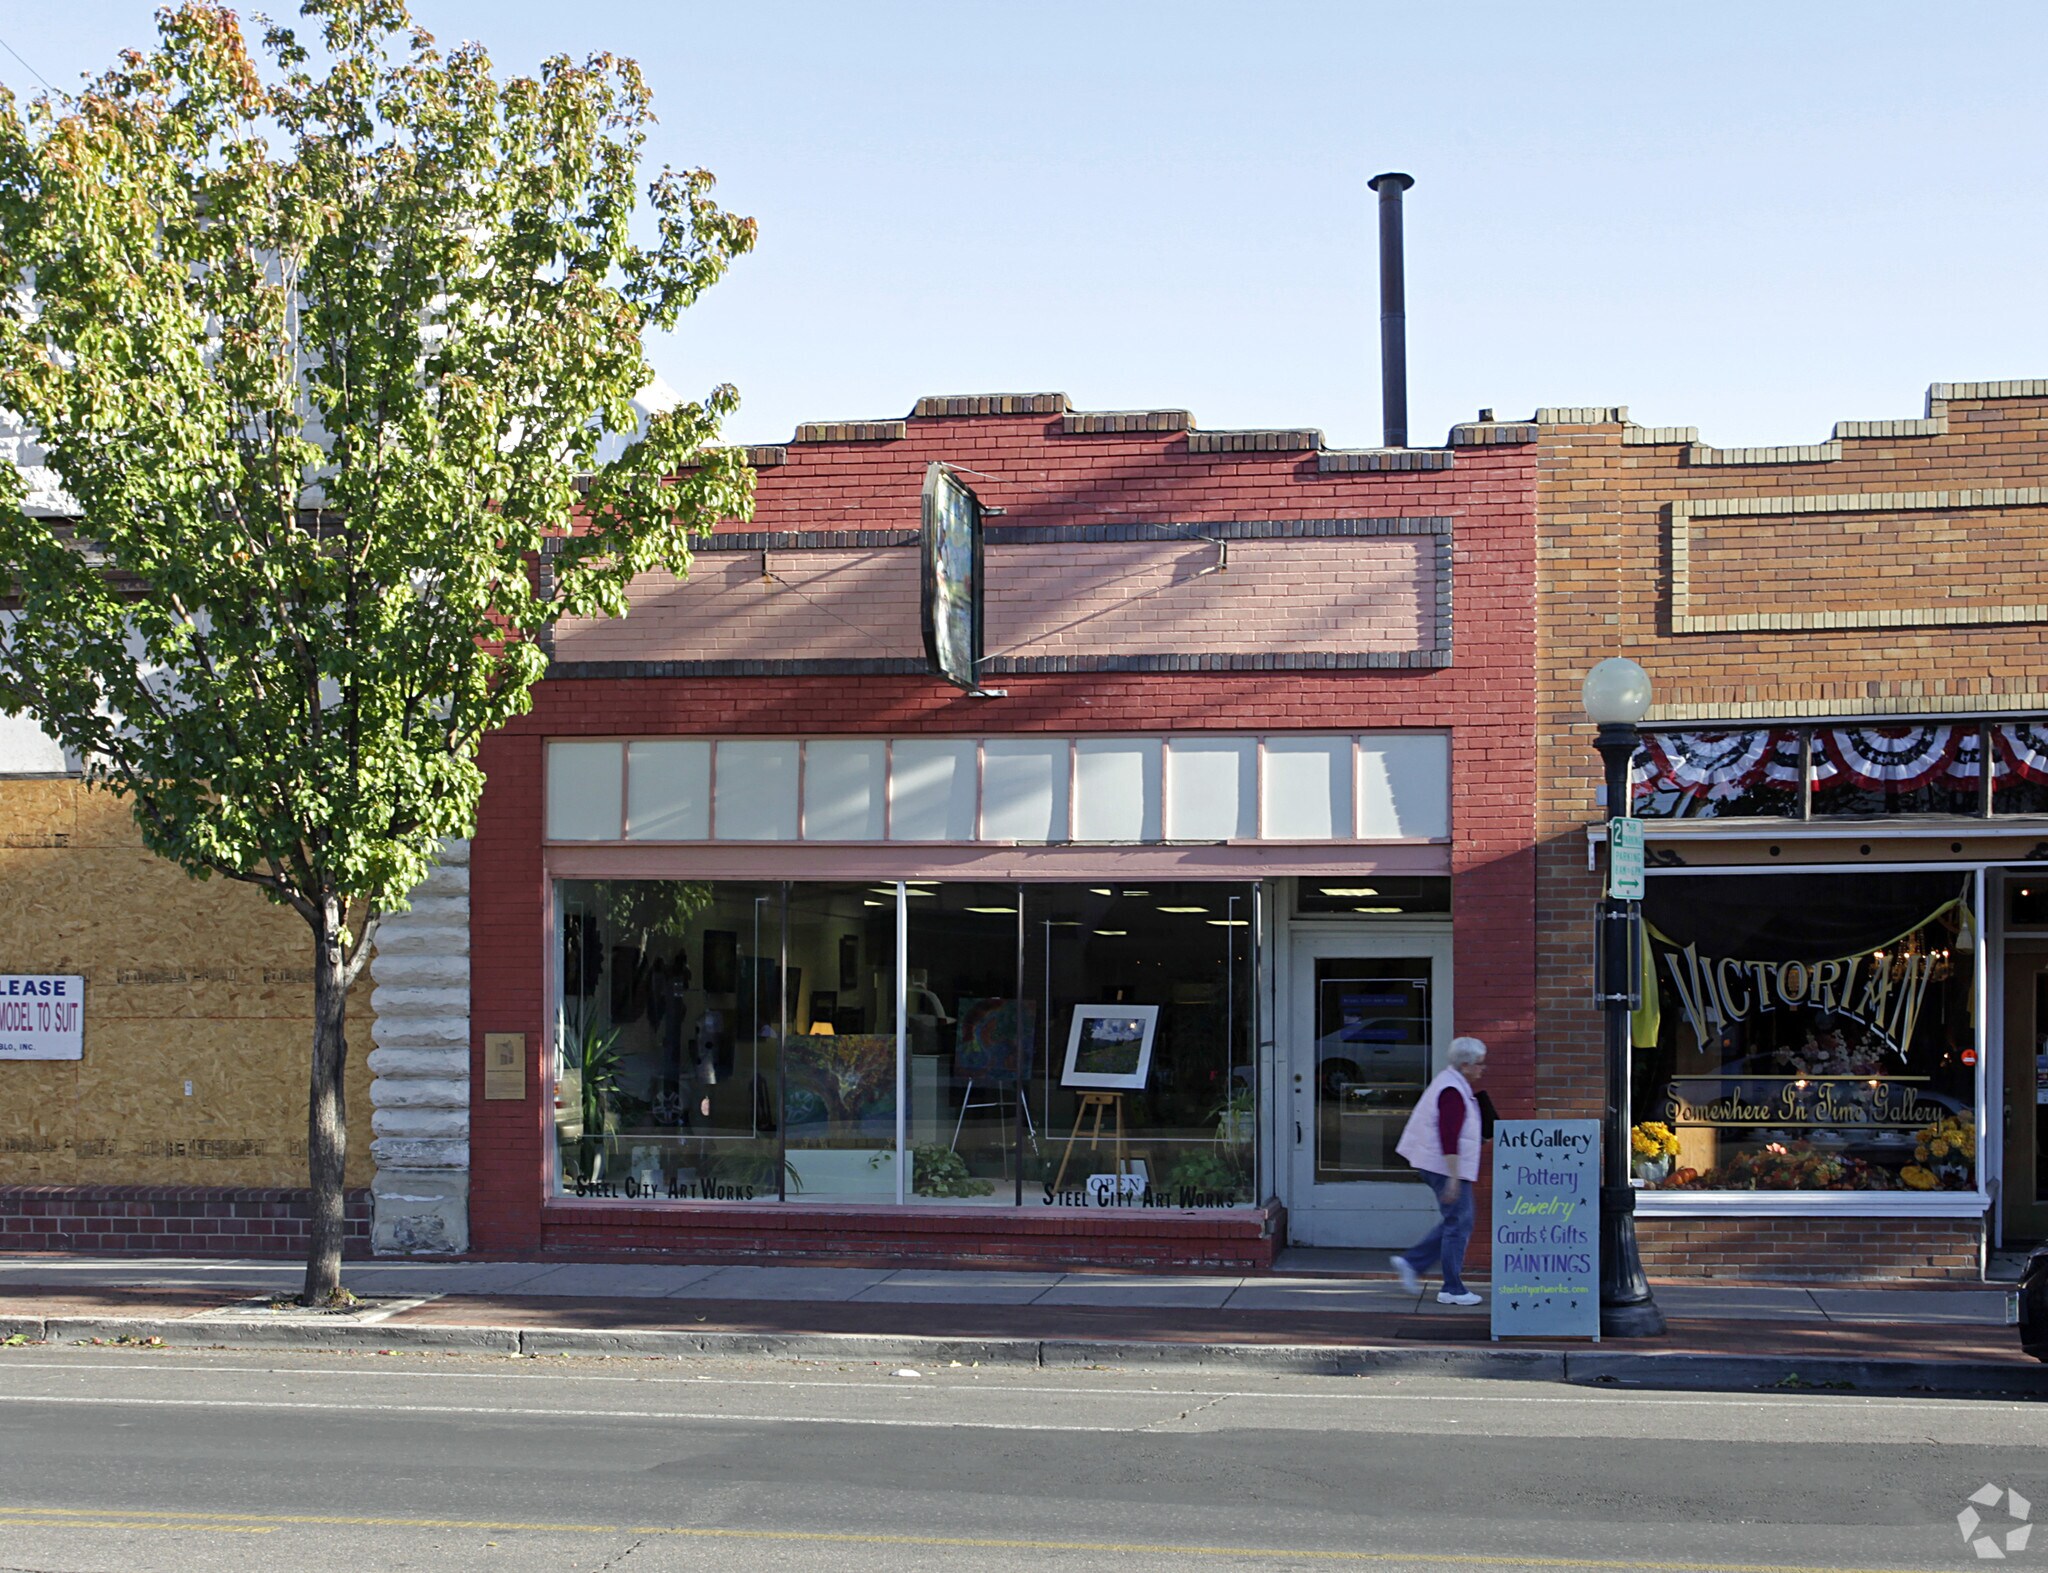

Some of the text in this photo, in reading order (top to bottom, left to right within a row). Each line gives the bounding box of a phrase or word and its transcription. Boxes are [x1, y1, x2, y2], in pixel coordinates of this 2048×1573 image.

[1614, 822, 1622, 843] 2
[1615, 851, 1641, 863] PARKING
[0, 980, 66, 996] LEASE
[1664, 941, 1936, 1065] VICTORIAN
[37, 1001, 51, 1032] TO
[55, 1001, 78, 1032] SUIT
[19, 1043, 36, 1051] INC.
[1665, 1082, 1944, 1137] Somewhere In Time Gallery
[1498, 1128, 1592, 1154] Art Gallery
[1090, 1176, 1141, 1193] OPEN
[1517, 1166, 1578, 1194] Pottery
[1507, 1195, 1576, 1222] Jewelry
[1497, 1224, 1588, 1244] Cards & Gifts
[1504, 1253, 1591, 1273] PAINTINGS
[1498, 1283, 1589, 1297] steelcityartworks.com
